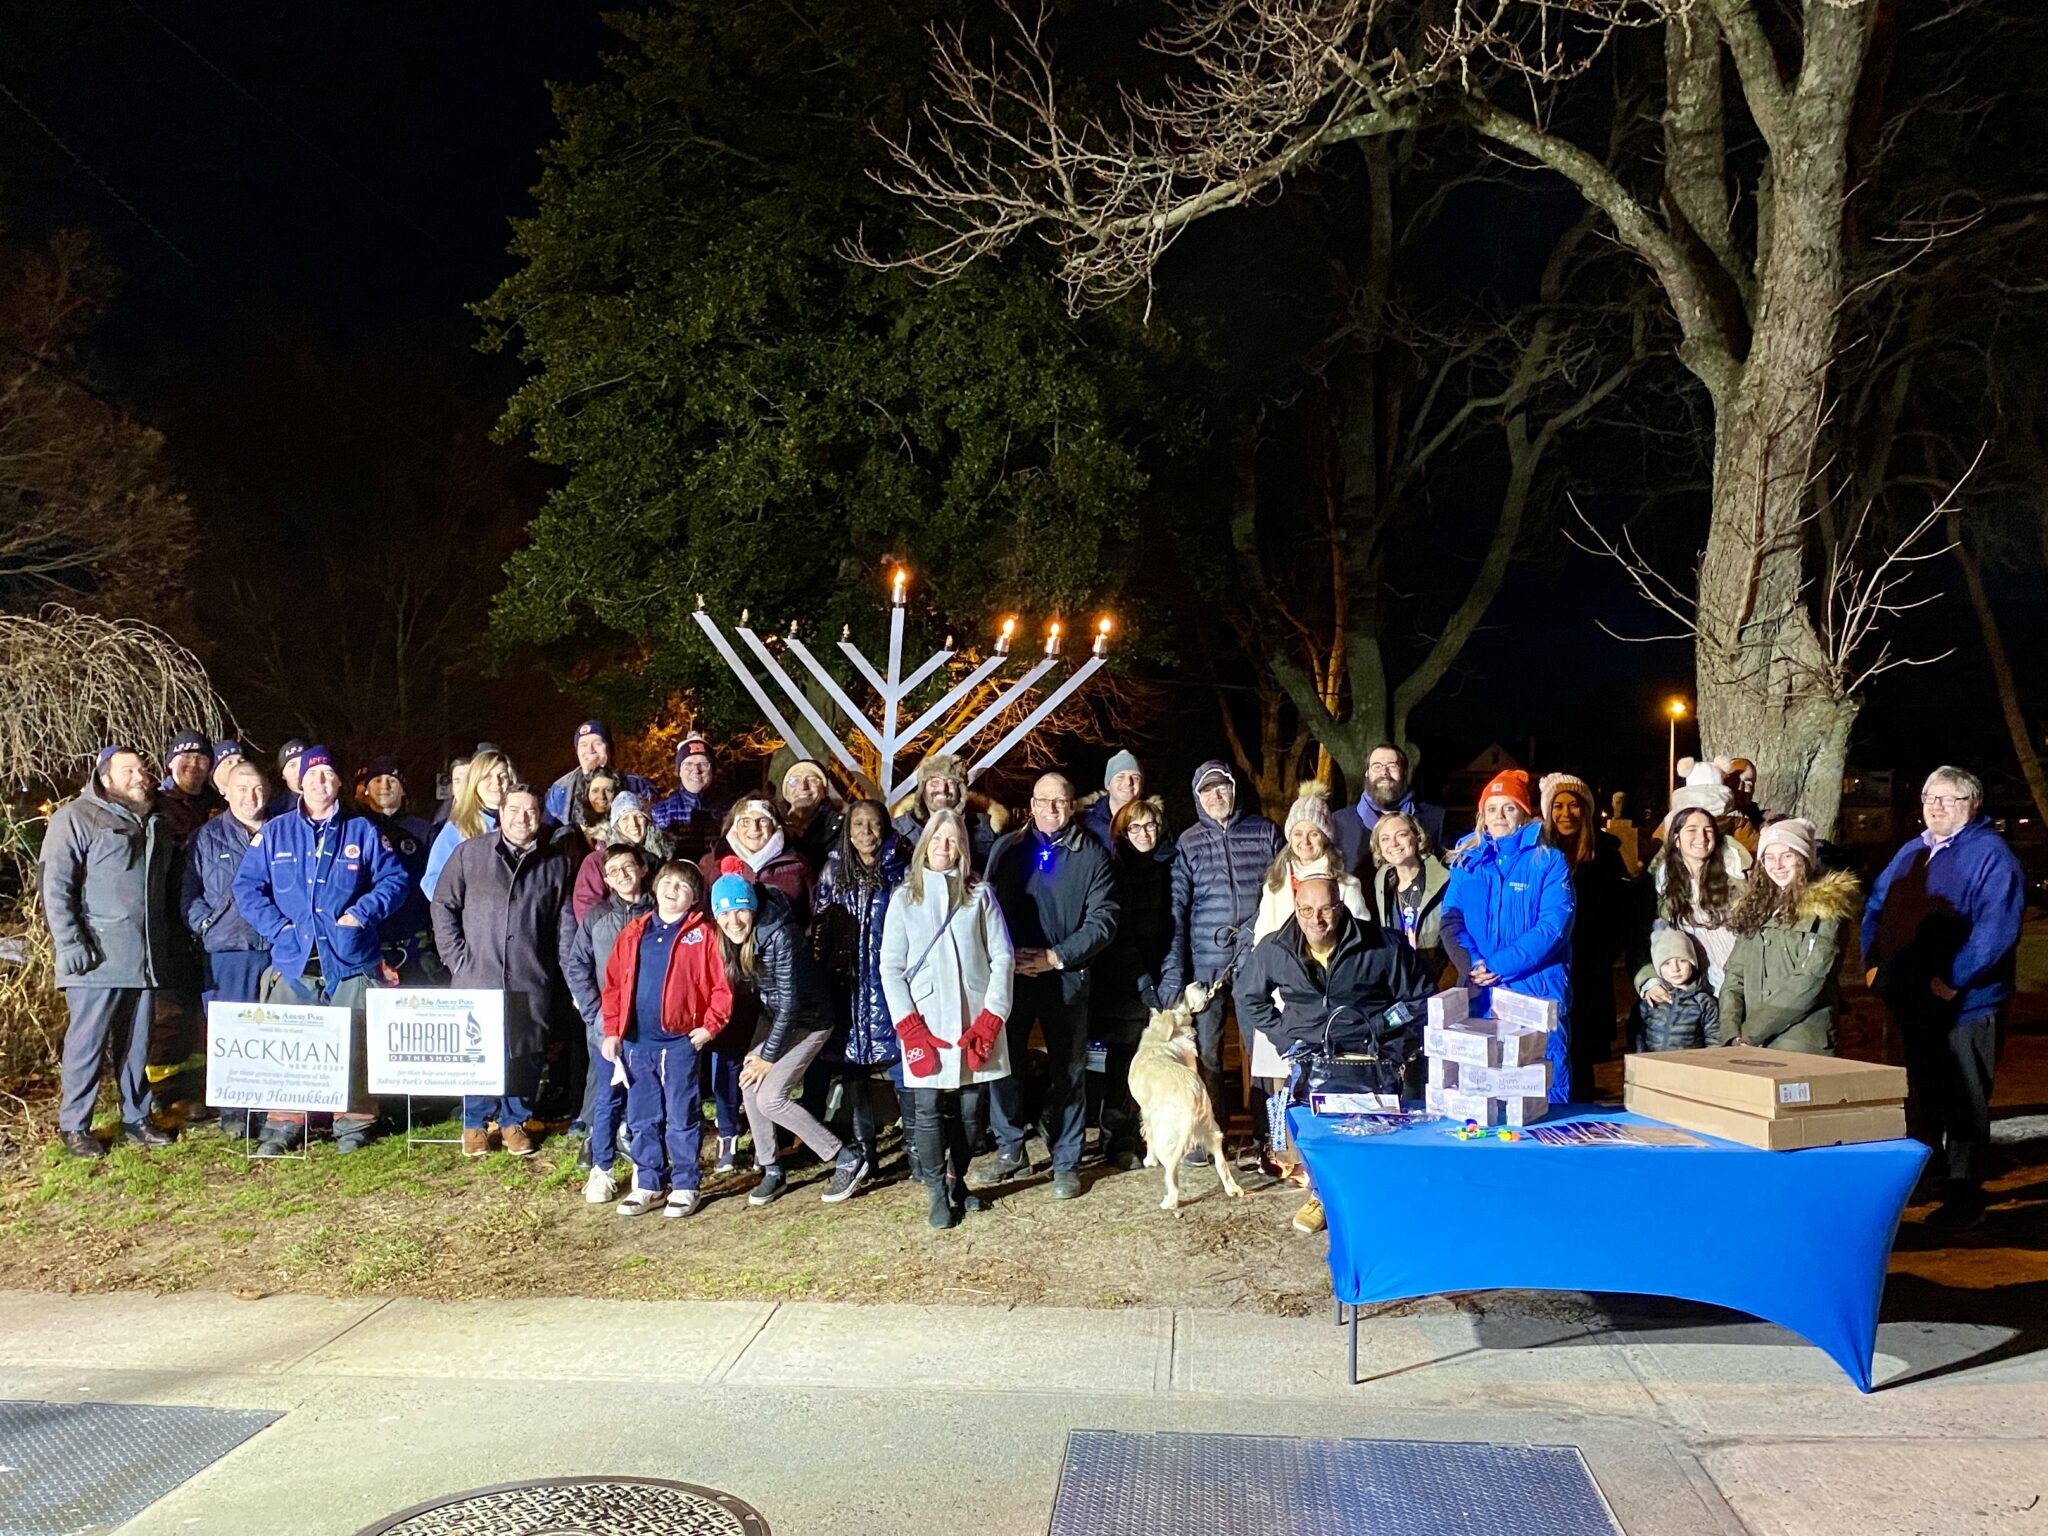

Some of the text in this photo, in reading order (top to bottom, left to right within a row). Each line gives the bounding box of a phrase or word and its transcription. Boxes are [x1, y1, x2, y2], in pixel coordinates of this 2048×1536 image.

[214, 1036, 341, 1065] SACKMAN
[388, 1021, 460, 1054] CHABAD
[214, 1086, 344, 1105] Happy Hanukkah!
